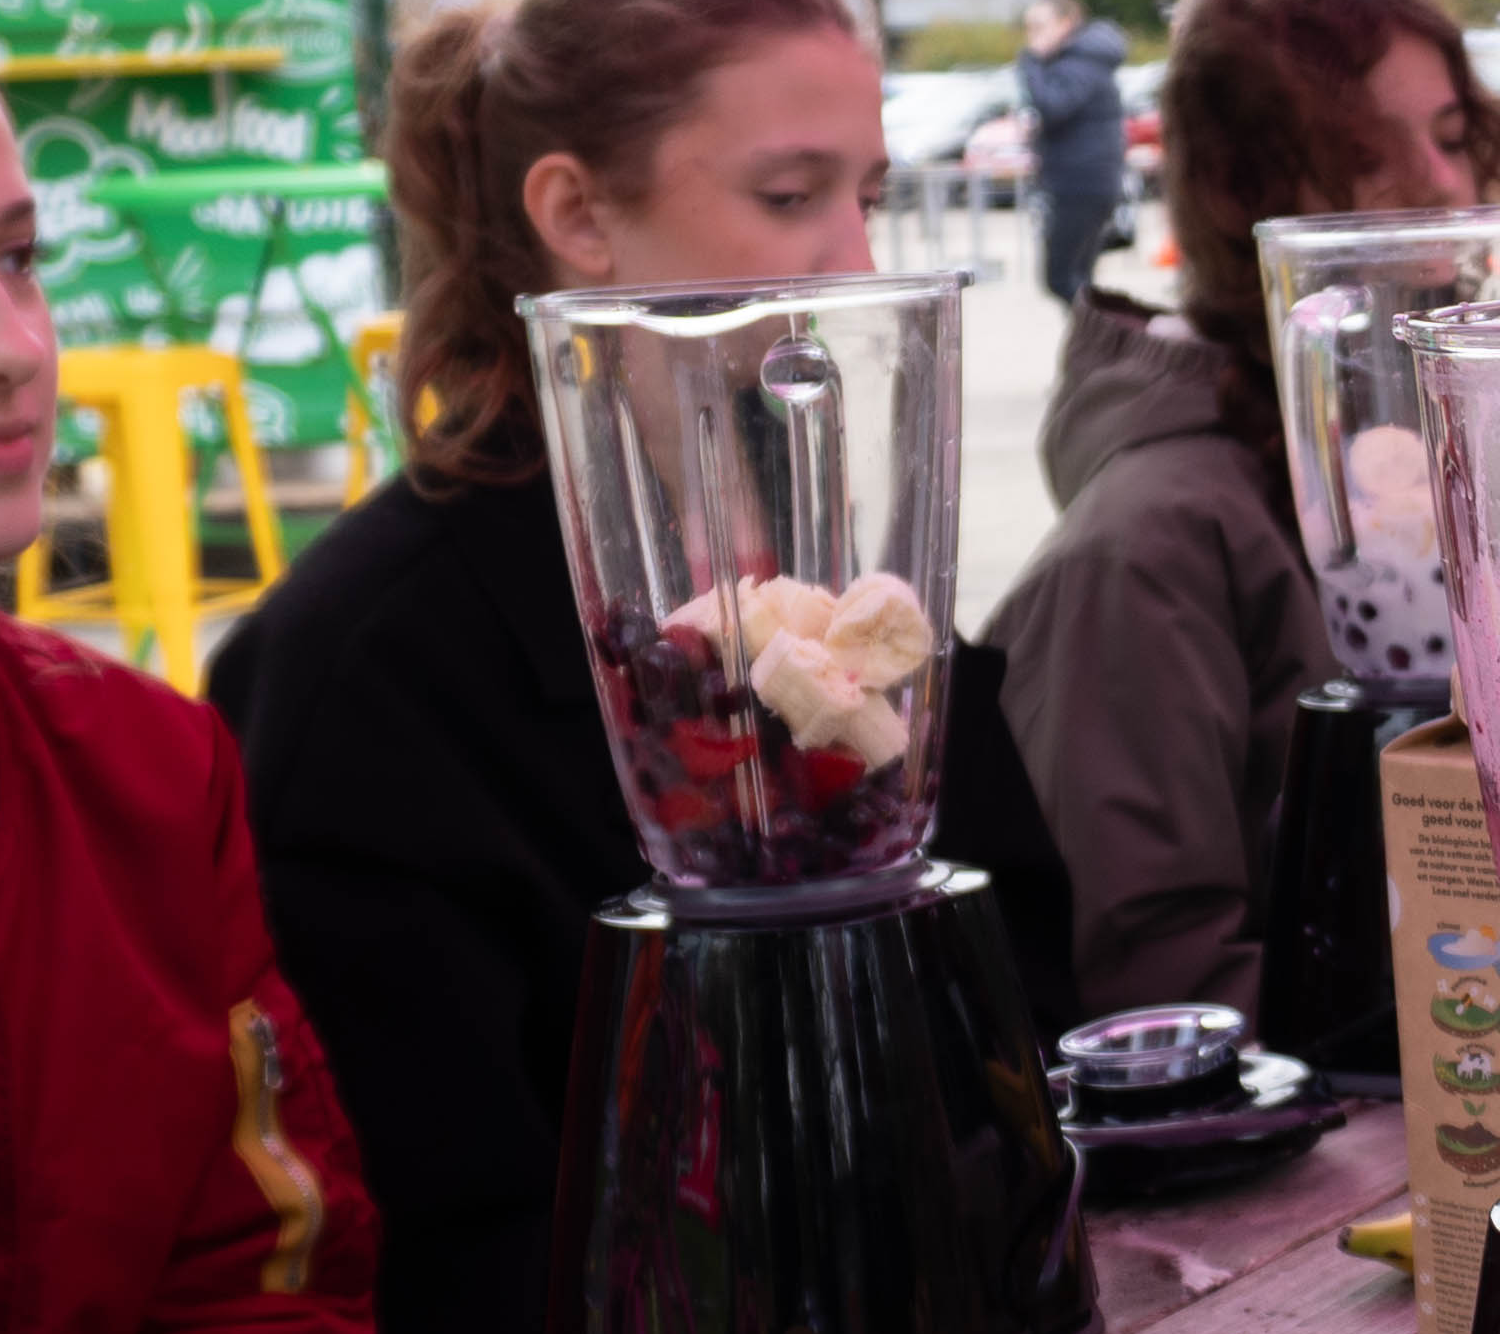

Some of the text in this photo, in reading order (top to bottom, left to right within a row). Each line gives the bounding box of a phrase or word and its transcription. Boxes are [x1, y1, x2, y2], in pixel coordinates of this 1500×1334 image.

[1392, 793, 1425, 808] Goed
[1428, 800, 1455, 810] voor
[1459, 797, 1474, 811] de
[1421, 812, 1483, 829] goed voor
